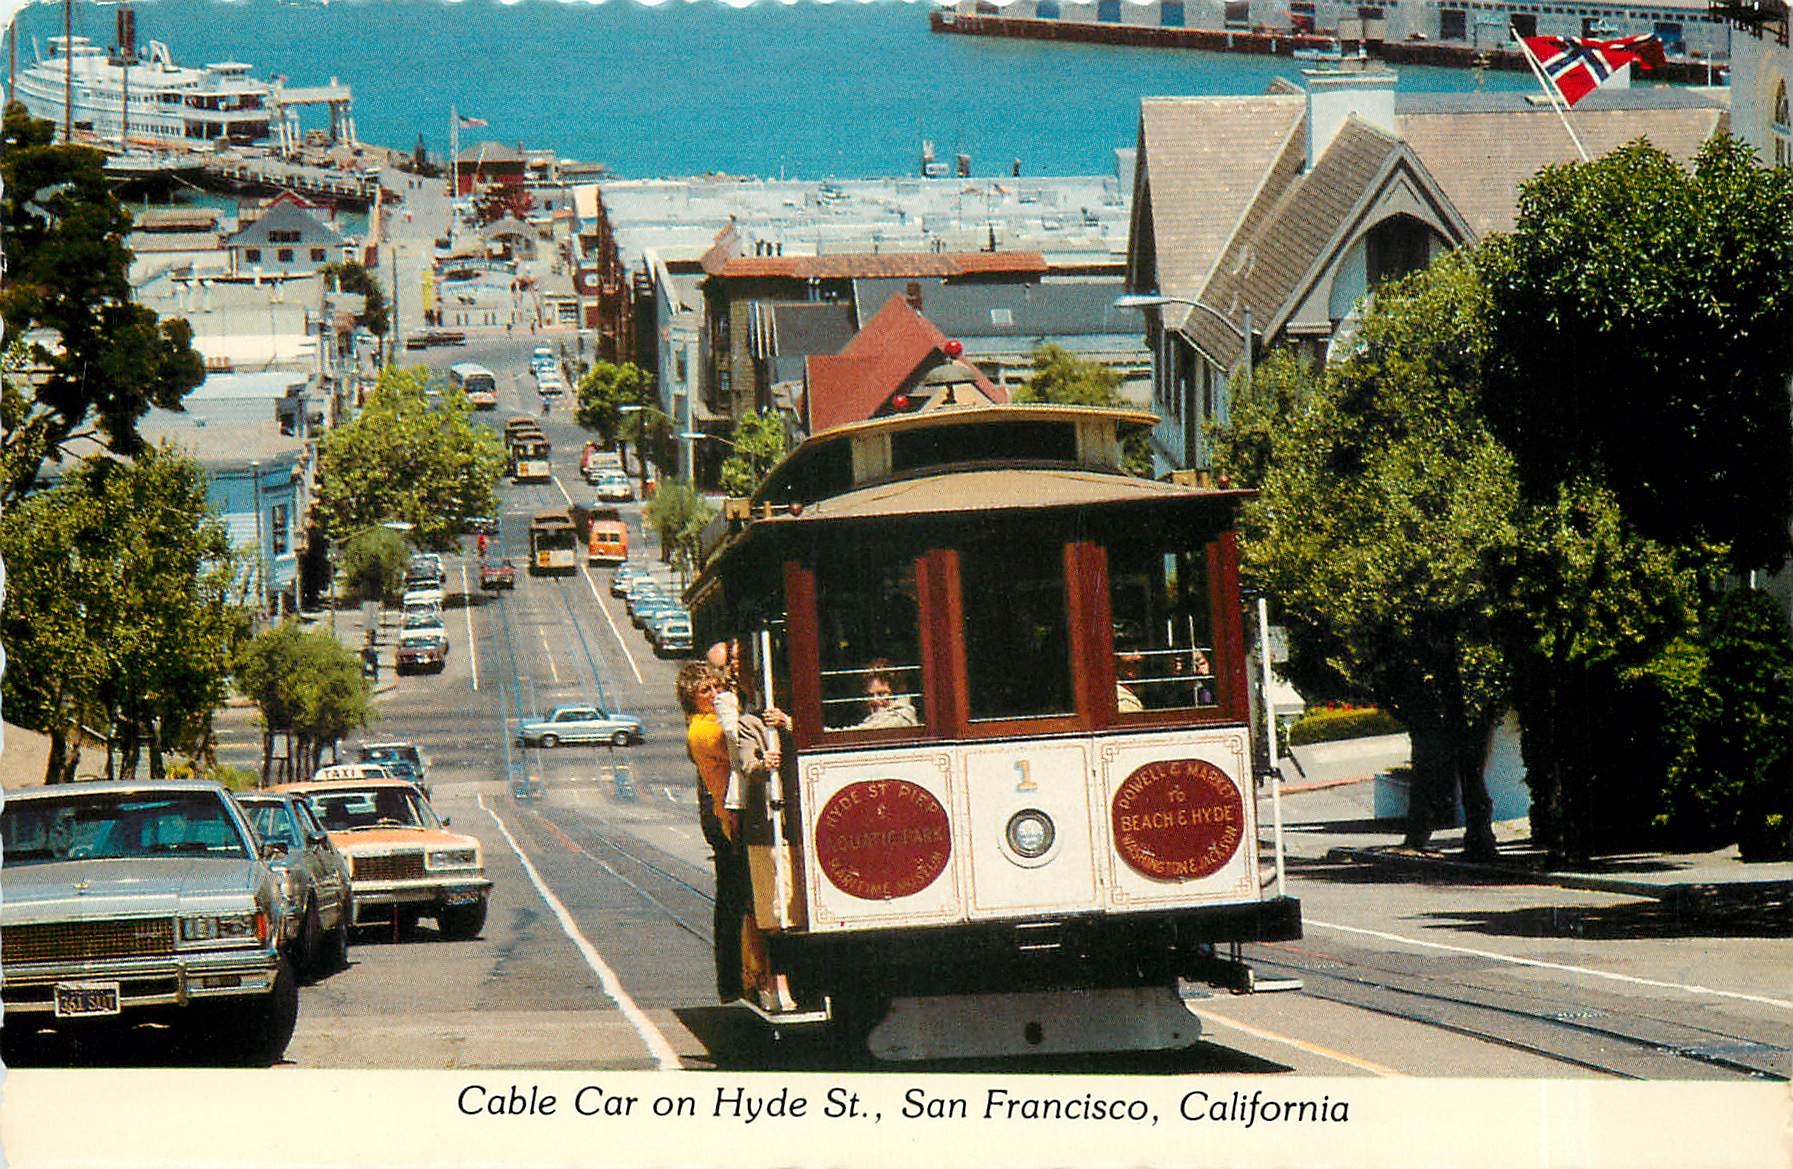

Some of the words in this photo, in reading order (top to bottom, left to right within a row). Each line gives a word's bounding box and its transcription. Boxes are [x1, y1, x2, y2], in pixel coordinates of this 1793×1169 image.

[323, 768, 355, 778] TAXI
[1014, 759, 1038, 792] 1
[1119, 766, 1168, 809] POWELL
[1186, 763, 1237, 798] MARKET
[825, 789, 863, 829] HYDE
[867, 783, 888, 799] ST
[898, 783, 940, 813] PIER
[1168, 789, 1186, 803] TO
[1121, 811, 1174, 832] BEACH
[1192, 804, 1234, 825] HYDE
